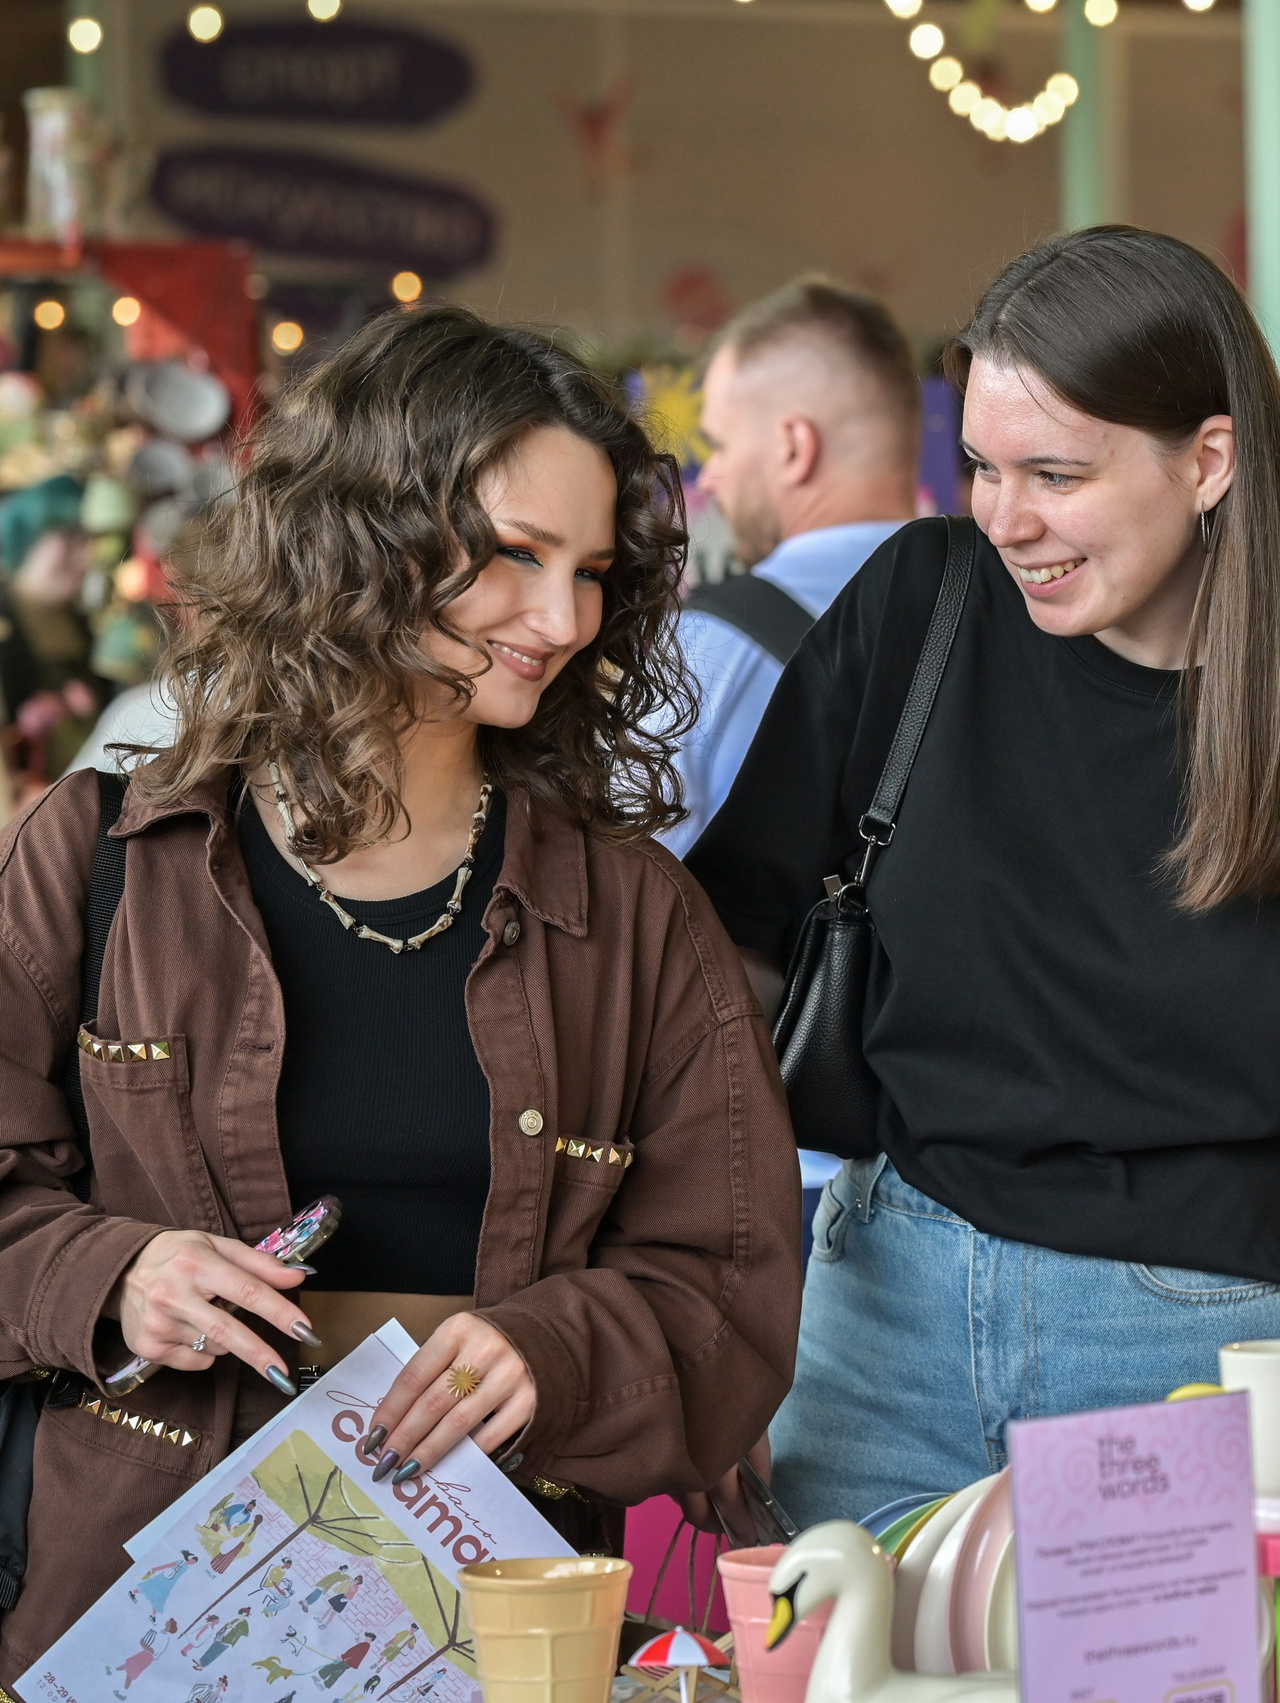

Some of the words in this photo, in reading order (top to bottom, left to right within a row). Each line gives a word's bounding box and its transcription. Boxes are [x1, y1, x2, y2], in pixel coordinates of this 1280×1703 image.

[1097, 1433, 1137, 1457] the
[1097, 1454, 1161, 1479] three
[1098, 1469, 1170, 1500] words
